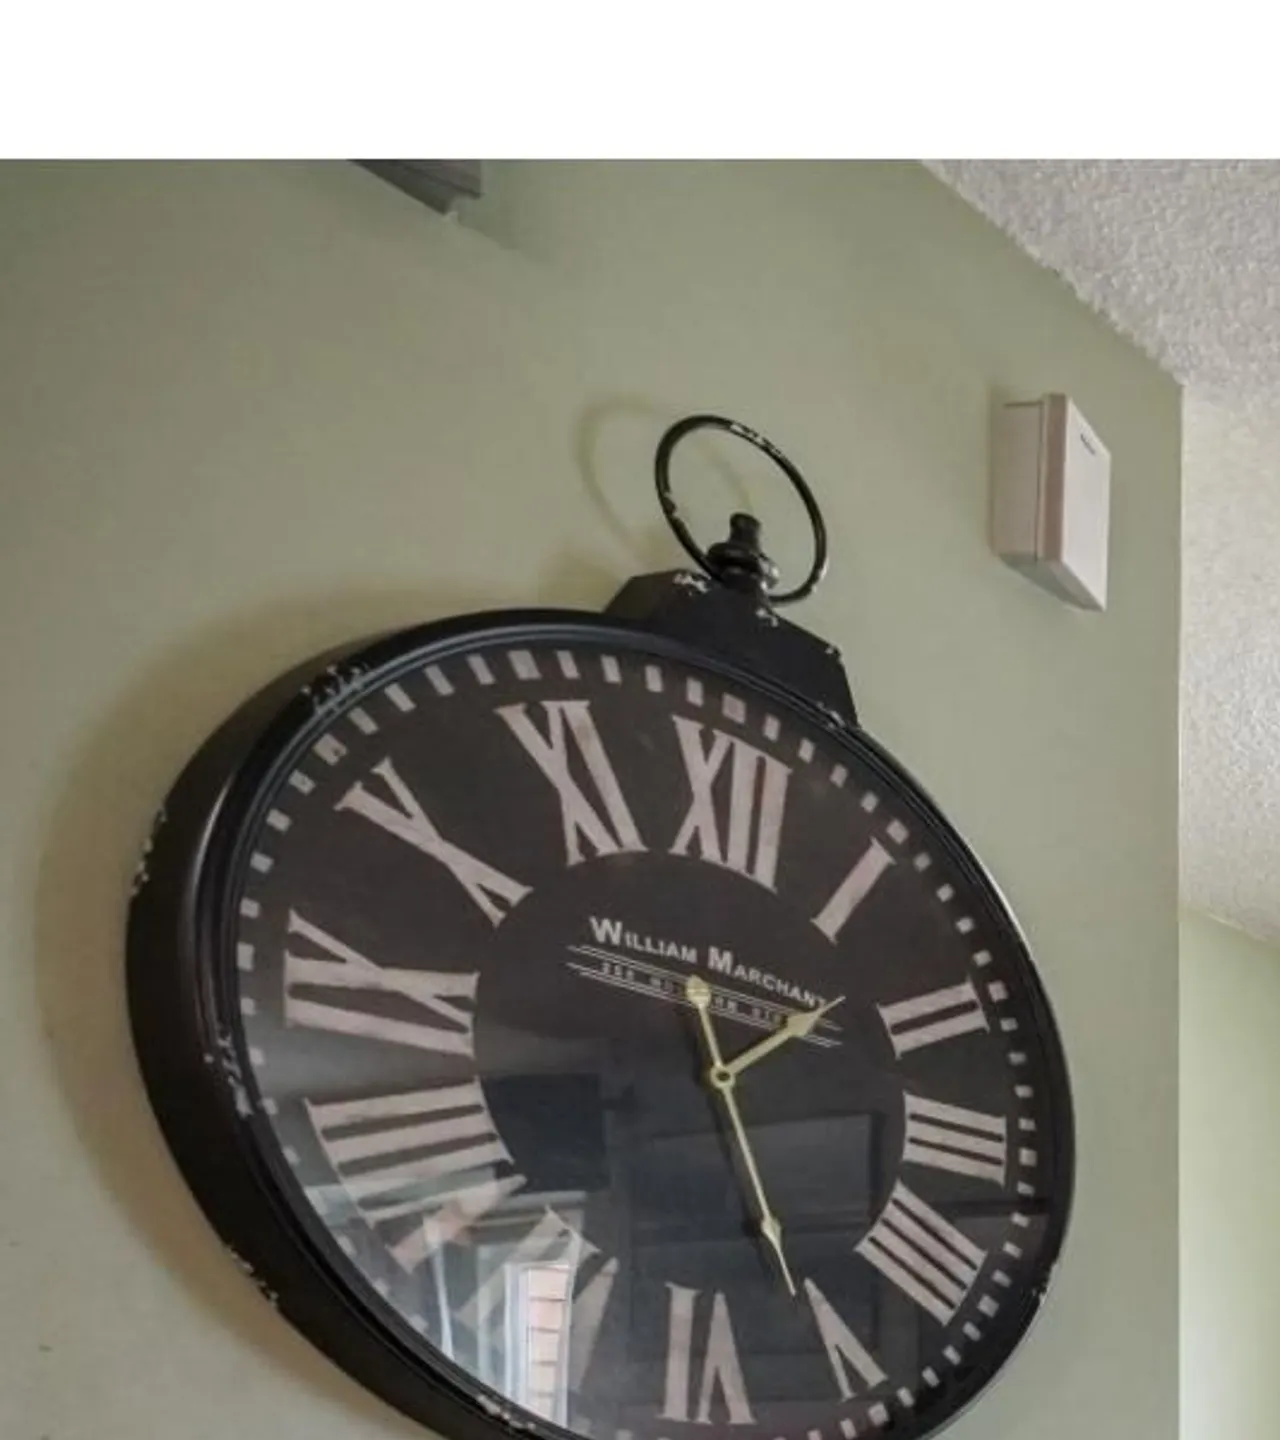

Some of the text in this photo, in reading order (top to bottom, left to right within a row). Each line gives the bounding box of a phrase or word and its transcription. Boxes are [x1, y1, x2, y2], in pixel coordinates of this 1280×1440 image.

[334, 756, 533, 927] X
[493, 699, 650, 868] XI
[668, 714, 793, 895] XII
[810, 836, 896, 945] I
[283, 908, 481, 1059] IX
[876, 975, 990, 1060] II
[902, 1090, 1006, 1187] III
[855, 1178, 987, 1326] IIII
[656, 1281, 758, 1425] VI
[803, 1277, 889, 1402] V
